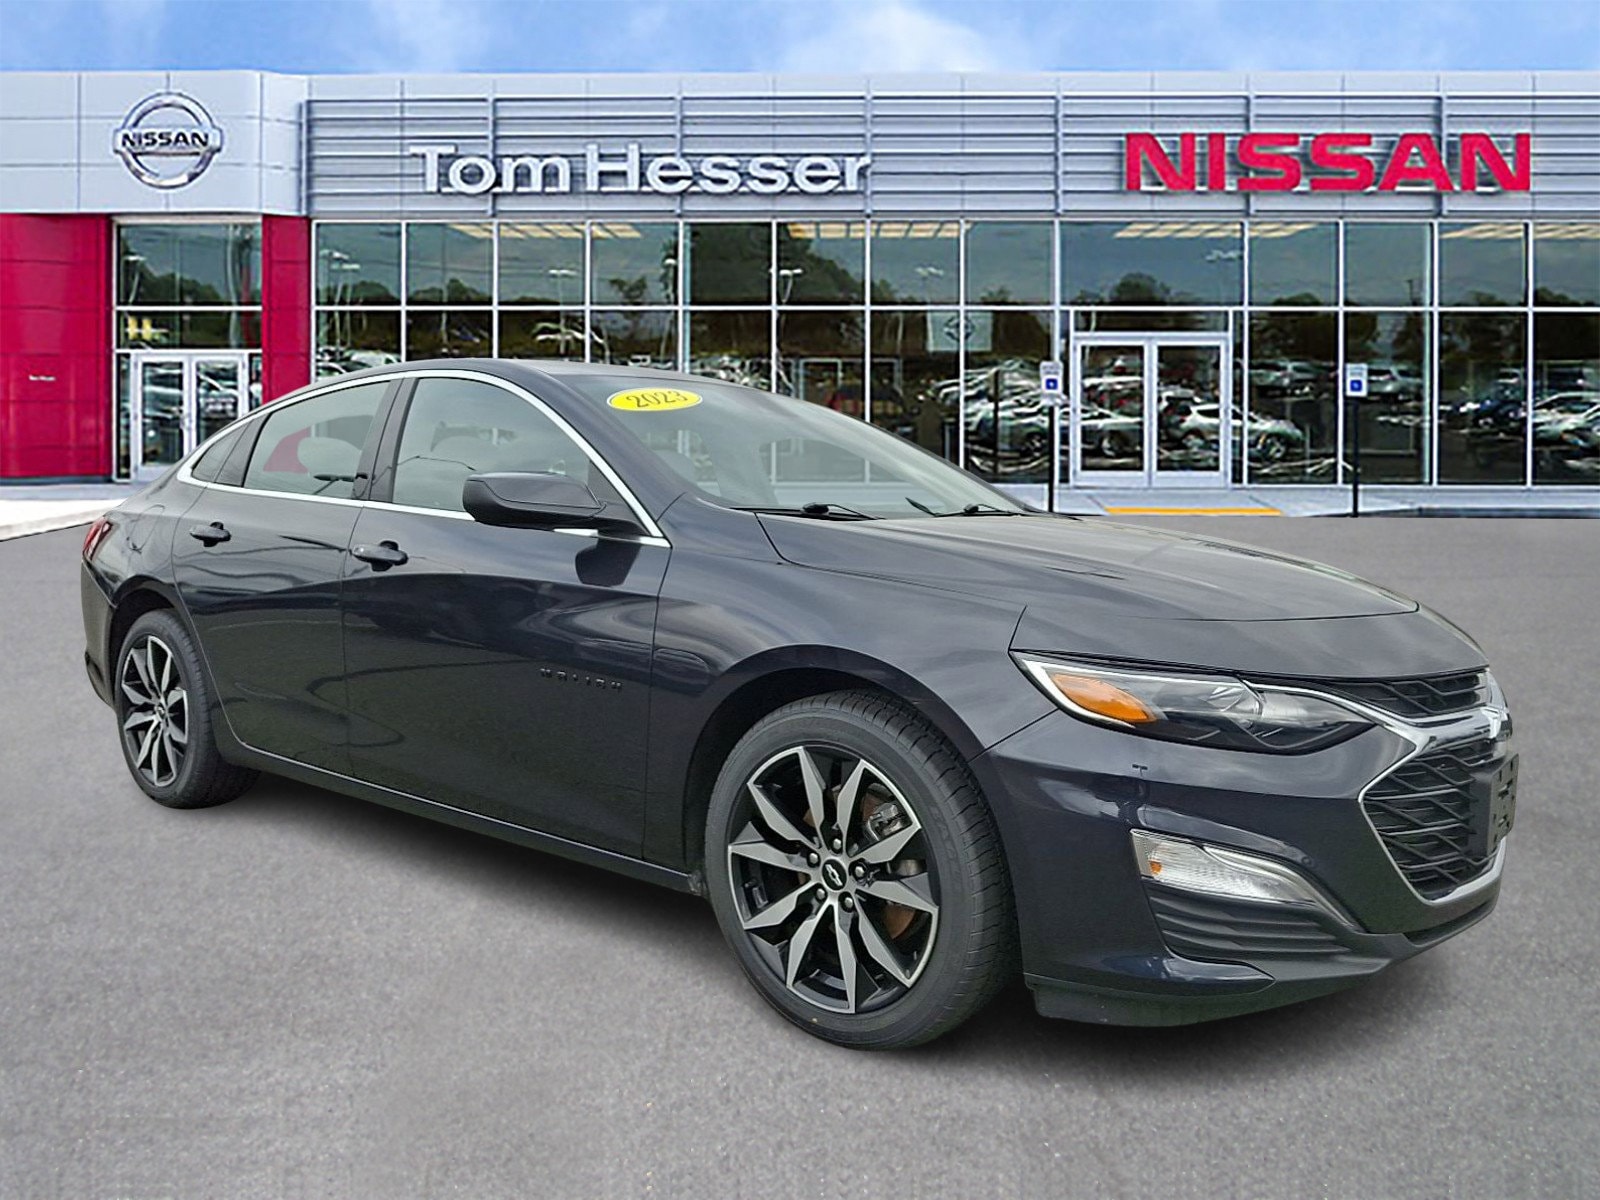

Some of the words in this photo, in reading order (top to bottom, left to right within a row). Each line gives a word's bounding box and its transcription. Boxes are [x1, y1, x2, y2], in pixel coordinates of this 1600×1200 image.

[122, 131, 209, 147] NISSAN
[409, 144, 570, 194] Tom
[585, 142, 871, 193] Hesser
[1125, 132, 1531, 191] NISSAN
[626, 390, 688, 408] 2023
